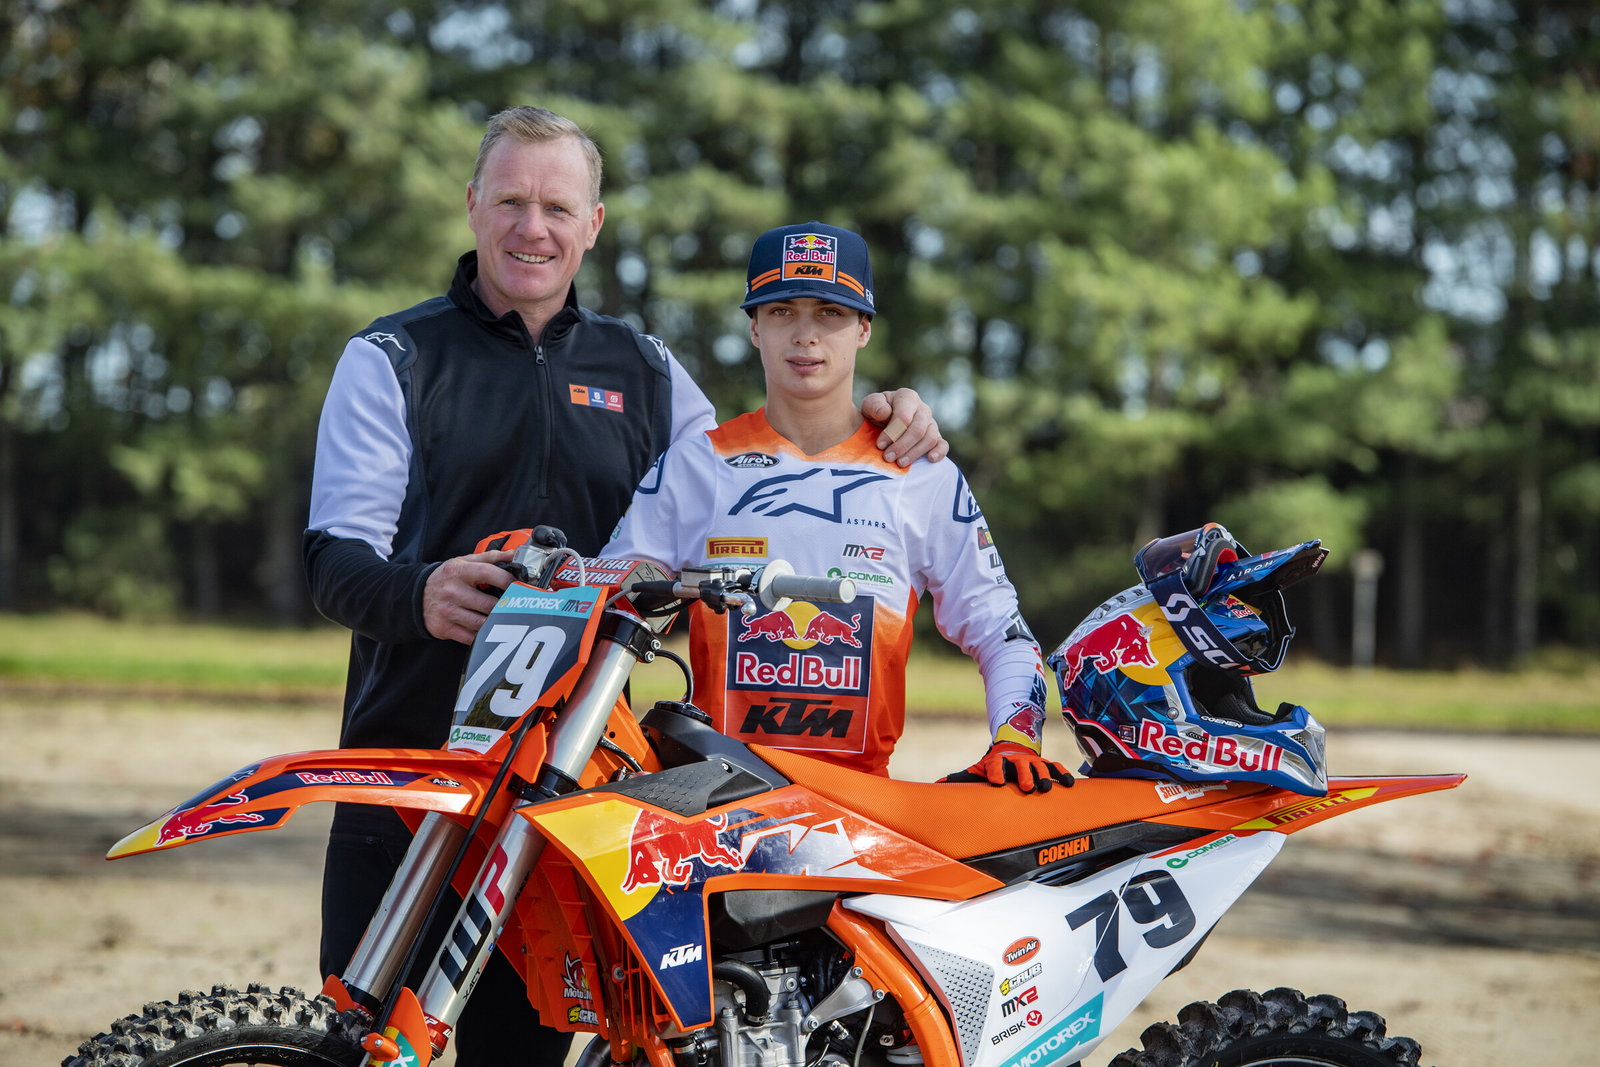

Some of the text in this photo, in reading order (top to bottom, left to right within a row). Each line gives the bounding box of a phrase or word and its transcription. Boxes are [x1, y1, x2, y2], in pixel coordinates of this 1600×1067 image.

[785, 249, 834, 263] Red Bull
[794, 265, 823, 276] KTM
[730, 455, 774, 465] Airoh
[846, 518, 887, 529] ASTARS
[709, 539, 764, 555] PIRELLI
[842, 543, 885, 560] MX2
[848, 571, 894, 585] COMISA
[1227, 559, 1276, 582] AIROH
[507, 596, 593, 614] MOTOREX MX2
[454, 624, 567, 717] 79
[735, 652, 862, 690] Red Bull
[739, 697, 854, 738] KTM
[1200, 715, 1243, 728] COENEN
[461, 732, 492, 743] COMISA
[1138, 717, 1211, 762] Red
[1212, 734, 1284, 772] Bull
[296, 771, 394, 785] Red Bull
[1160, 785, 1182, 799] SELLE
[1263, 794, 1352, 825] PIRELLI
[1038, 835, 1090, 866] COENEN
[1186, 835, 1236, 858] COMISA
[1065, 869, 1196, 982] 79
[660, 943, 702, 970] KTM
[1006, 940, 1039, 963] Twin Air
[1001, 985, 1039, 1018] MX2
[991, 1020, 1026, 1046] BRISK
[1011, 1011, 1097, 1067] MOTOREX
